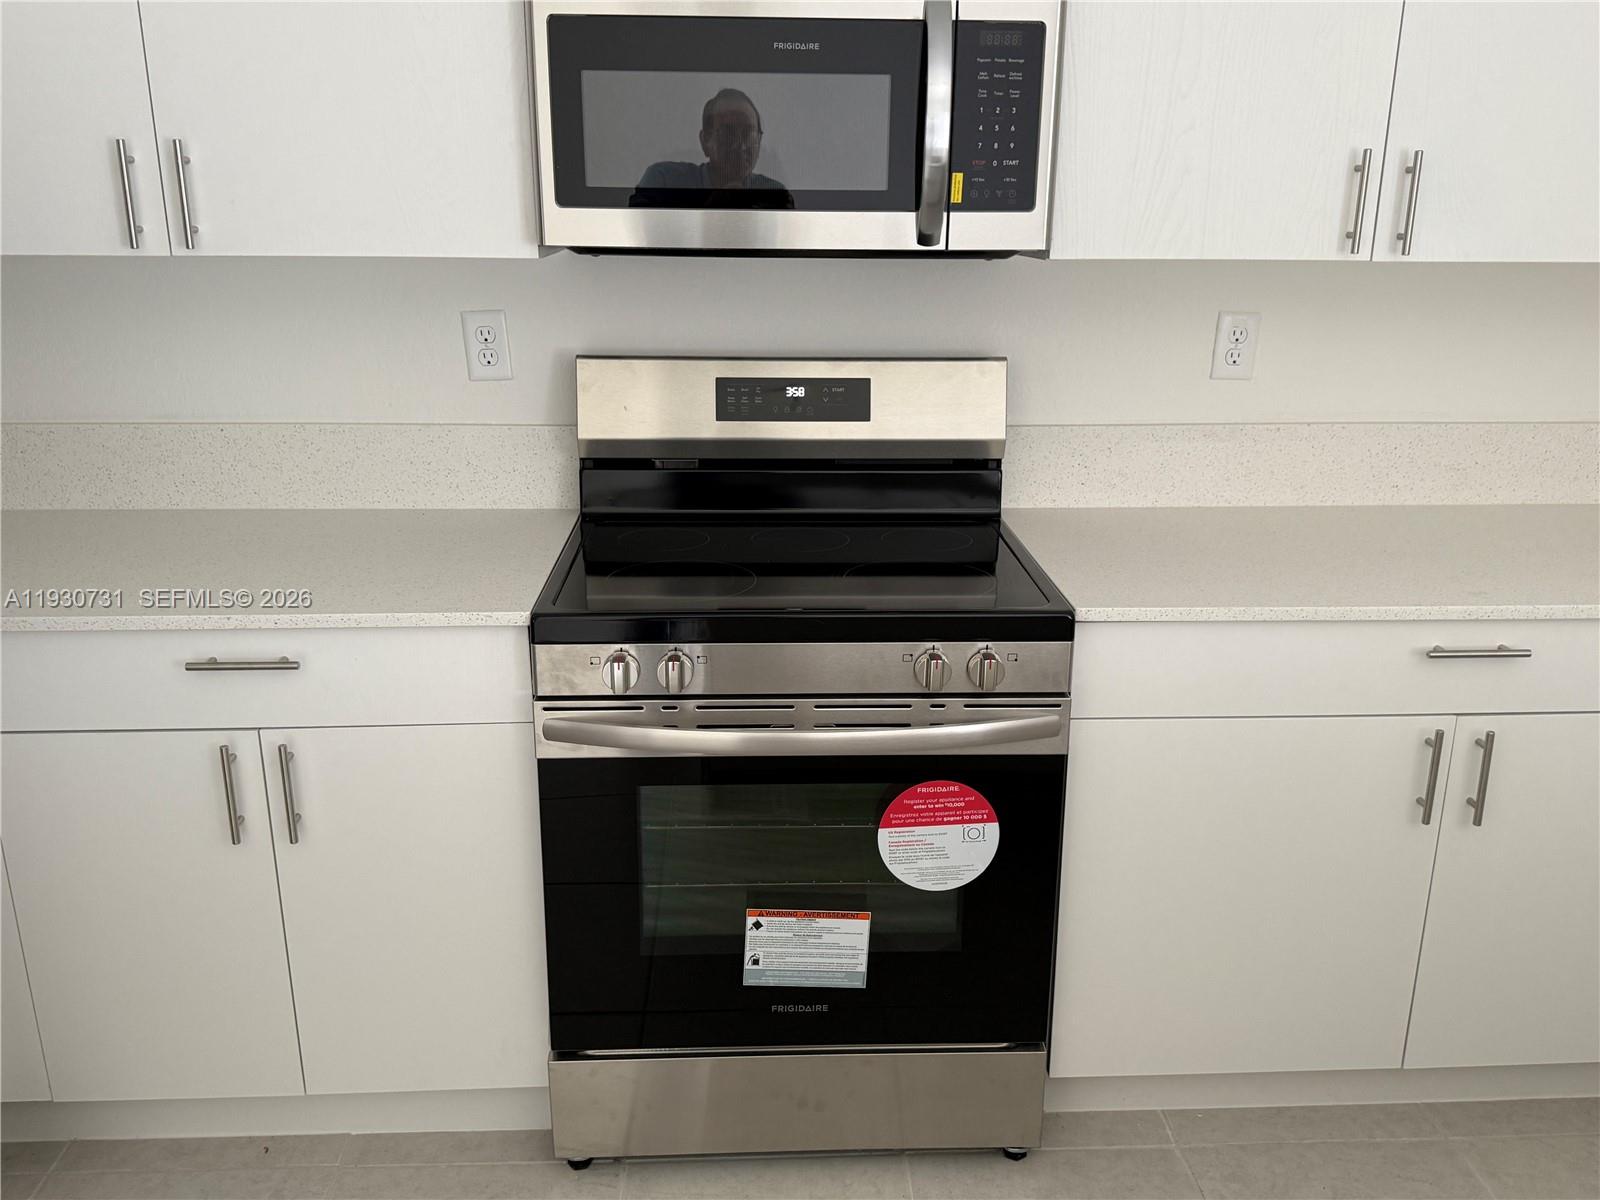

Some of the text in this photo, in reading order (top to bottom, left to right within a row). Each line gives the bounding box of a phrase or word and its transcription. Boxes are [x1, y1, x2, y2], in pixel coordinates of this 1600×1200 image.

[773, 42, 820, 50] FRIGIDAIRE
[995, 106, 1000, 114] 2
[978, 124, 983, 132] 4
[994, 124, 999, 132] 5
[1010, 124, 1015, 132] 6
[917, 785, 960, 793] FRIGIDAIRE
[765, 910, 798, 918] WARNING
[803, 911, 860, 920] AVERTISSEMENT
[771, 1004, 830, 1013] FRIGIDAIRE
